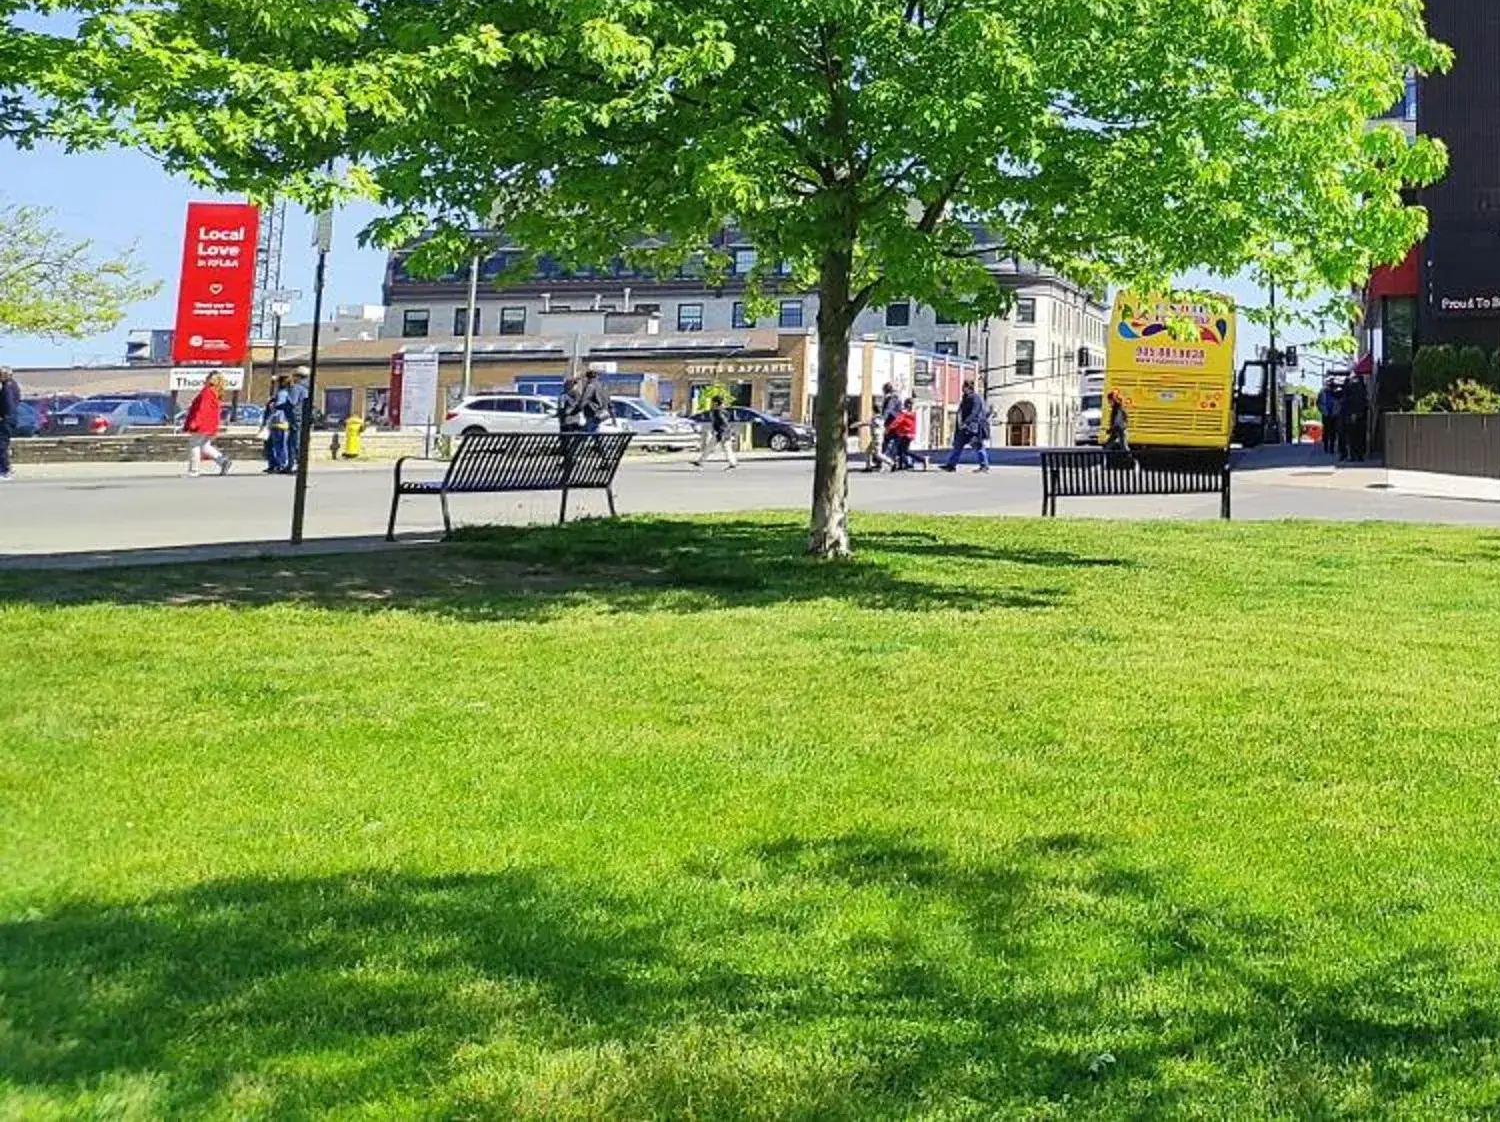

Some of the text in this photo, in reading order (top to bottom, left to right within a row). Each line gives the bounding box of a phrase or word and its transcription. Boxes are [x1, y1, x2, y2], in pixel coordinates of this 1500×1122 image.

[199, 225, 245, 241] Local
[197, 241, 241, 256] Love
[1441, 297, 1475, 309] Proud
[1475, 297, 1491, 308] To
[687, 364, 724, 375] GIFTS
[737, 363, 795, 374] APPAREL
